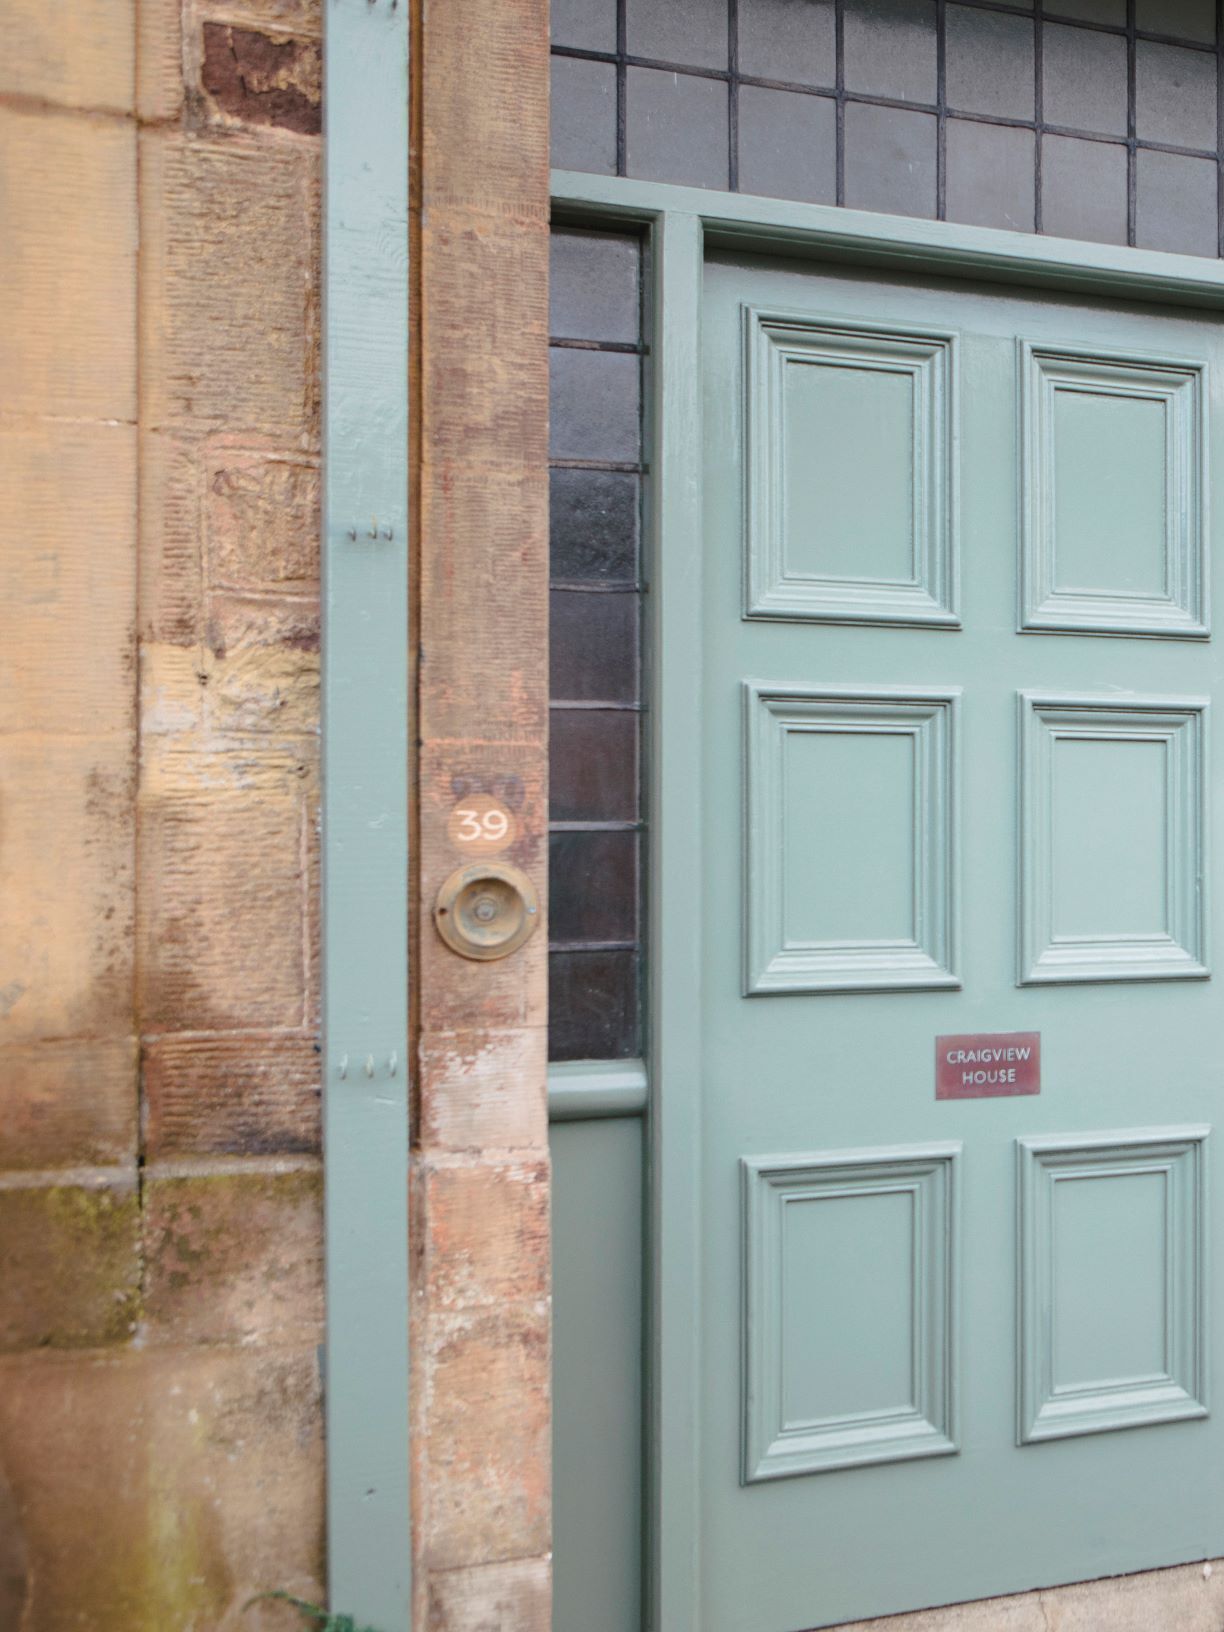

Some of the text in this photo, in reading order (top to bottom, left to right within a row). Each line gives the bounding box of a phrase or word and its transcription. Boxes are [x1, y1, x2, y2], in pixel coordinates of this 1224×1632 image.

[456, 810, 508, 841] 39
[946, 1047, 1031, 1065] CRAIGVIEW
[962, 1068, 1017, 1085] HOUSE
